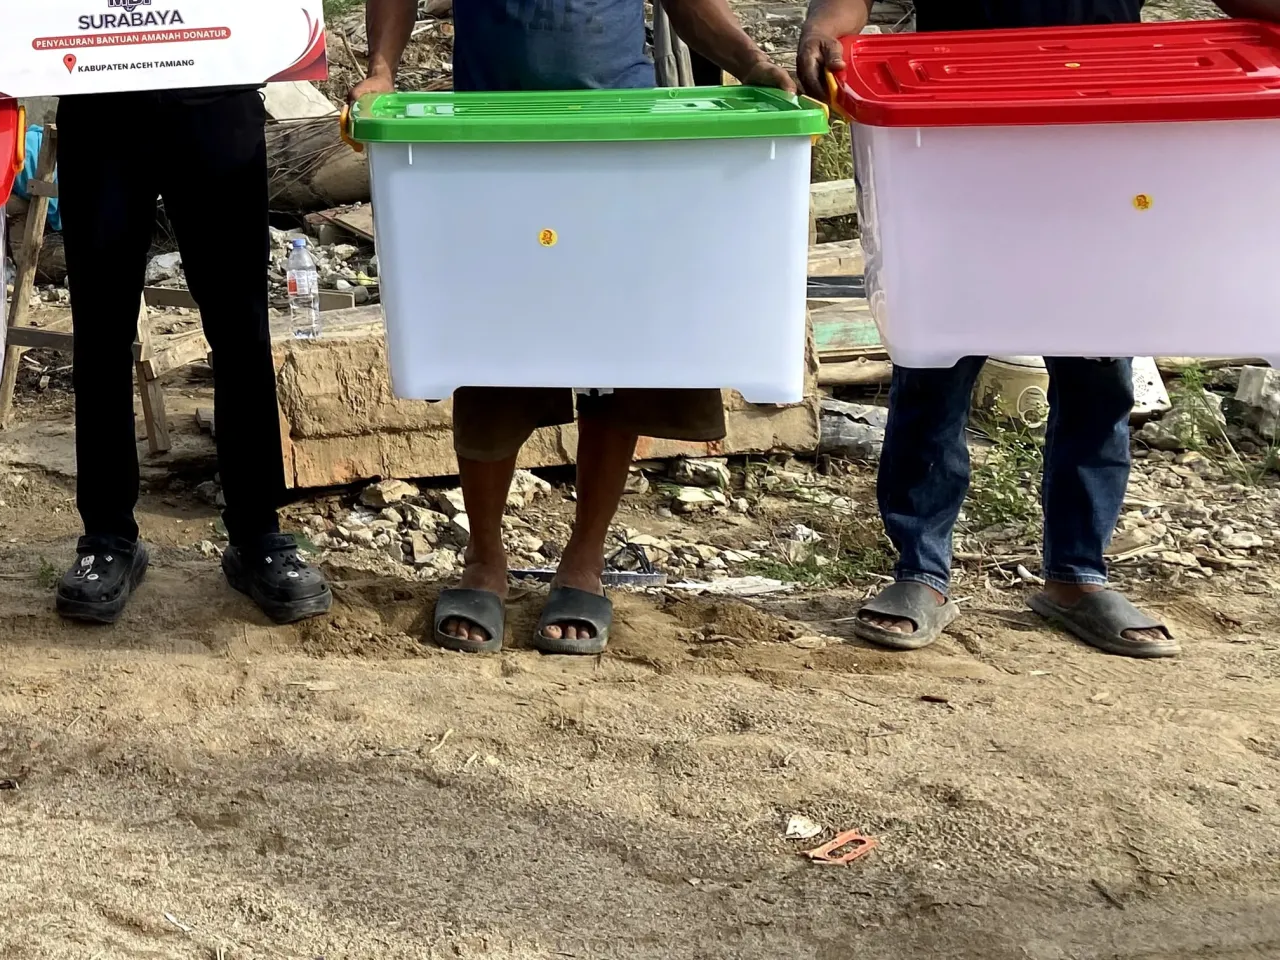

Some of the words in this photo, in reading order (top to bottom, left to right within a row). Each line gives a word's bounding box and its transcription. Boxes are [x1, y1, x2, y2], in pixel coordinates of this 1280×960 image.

[78, 9, 185, 30] SURABAYA
[36, 34, 95, 48] PENYALURAN
[96, 34, 140, 46] BANTUAN
[141, 32, 181, 42] AMANAH
[183, 29, 227, 39] DONATUR
[77, 62, 129, 73] KABUPATEN
[129, 61, 153, 70] ACEH
[153, 59, 195, 68] TAMIANG
